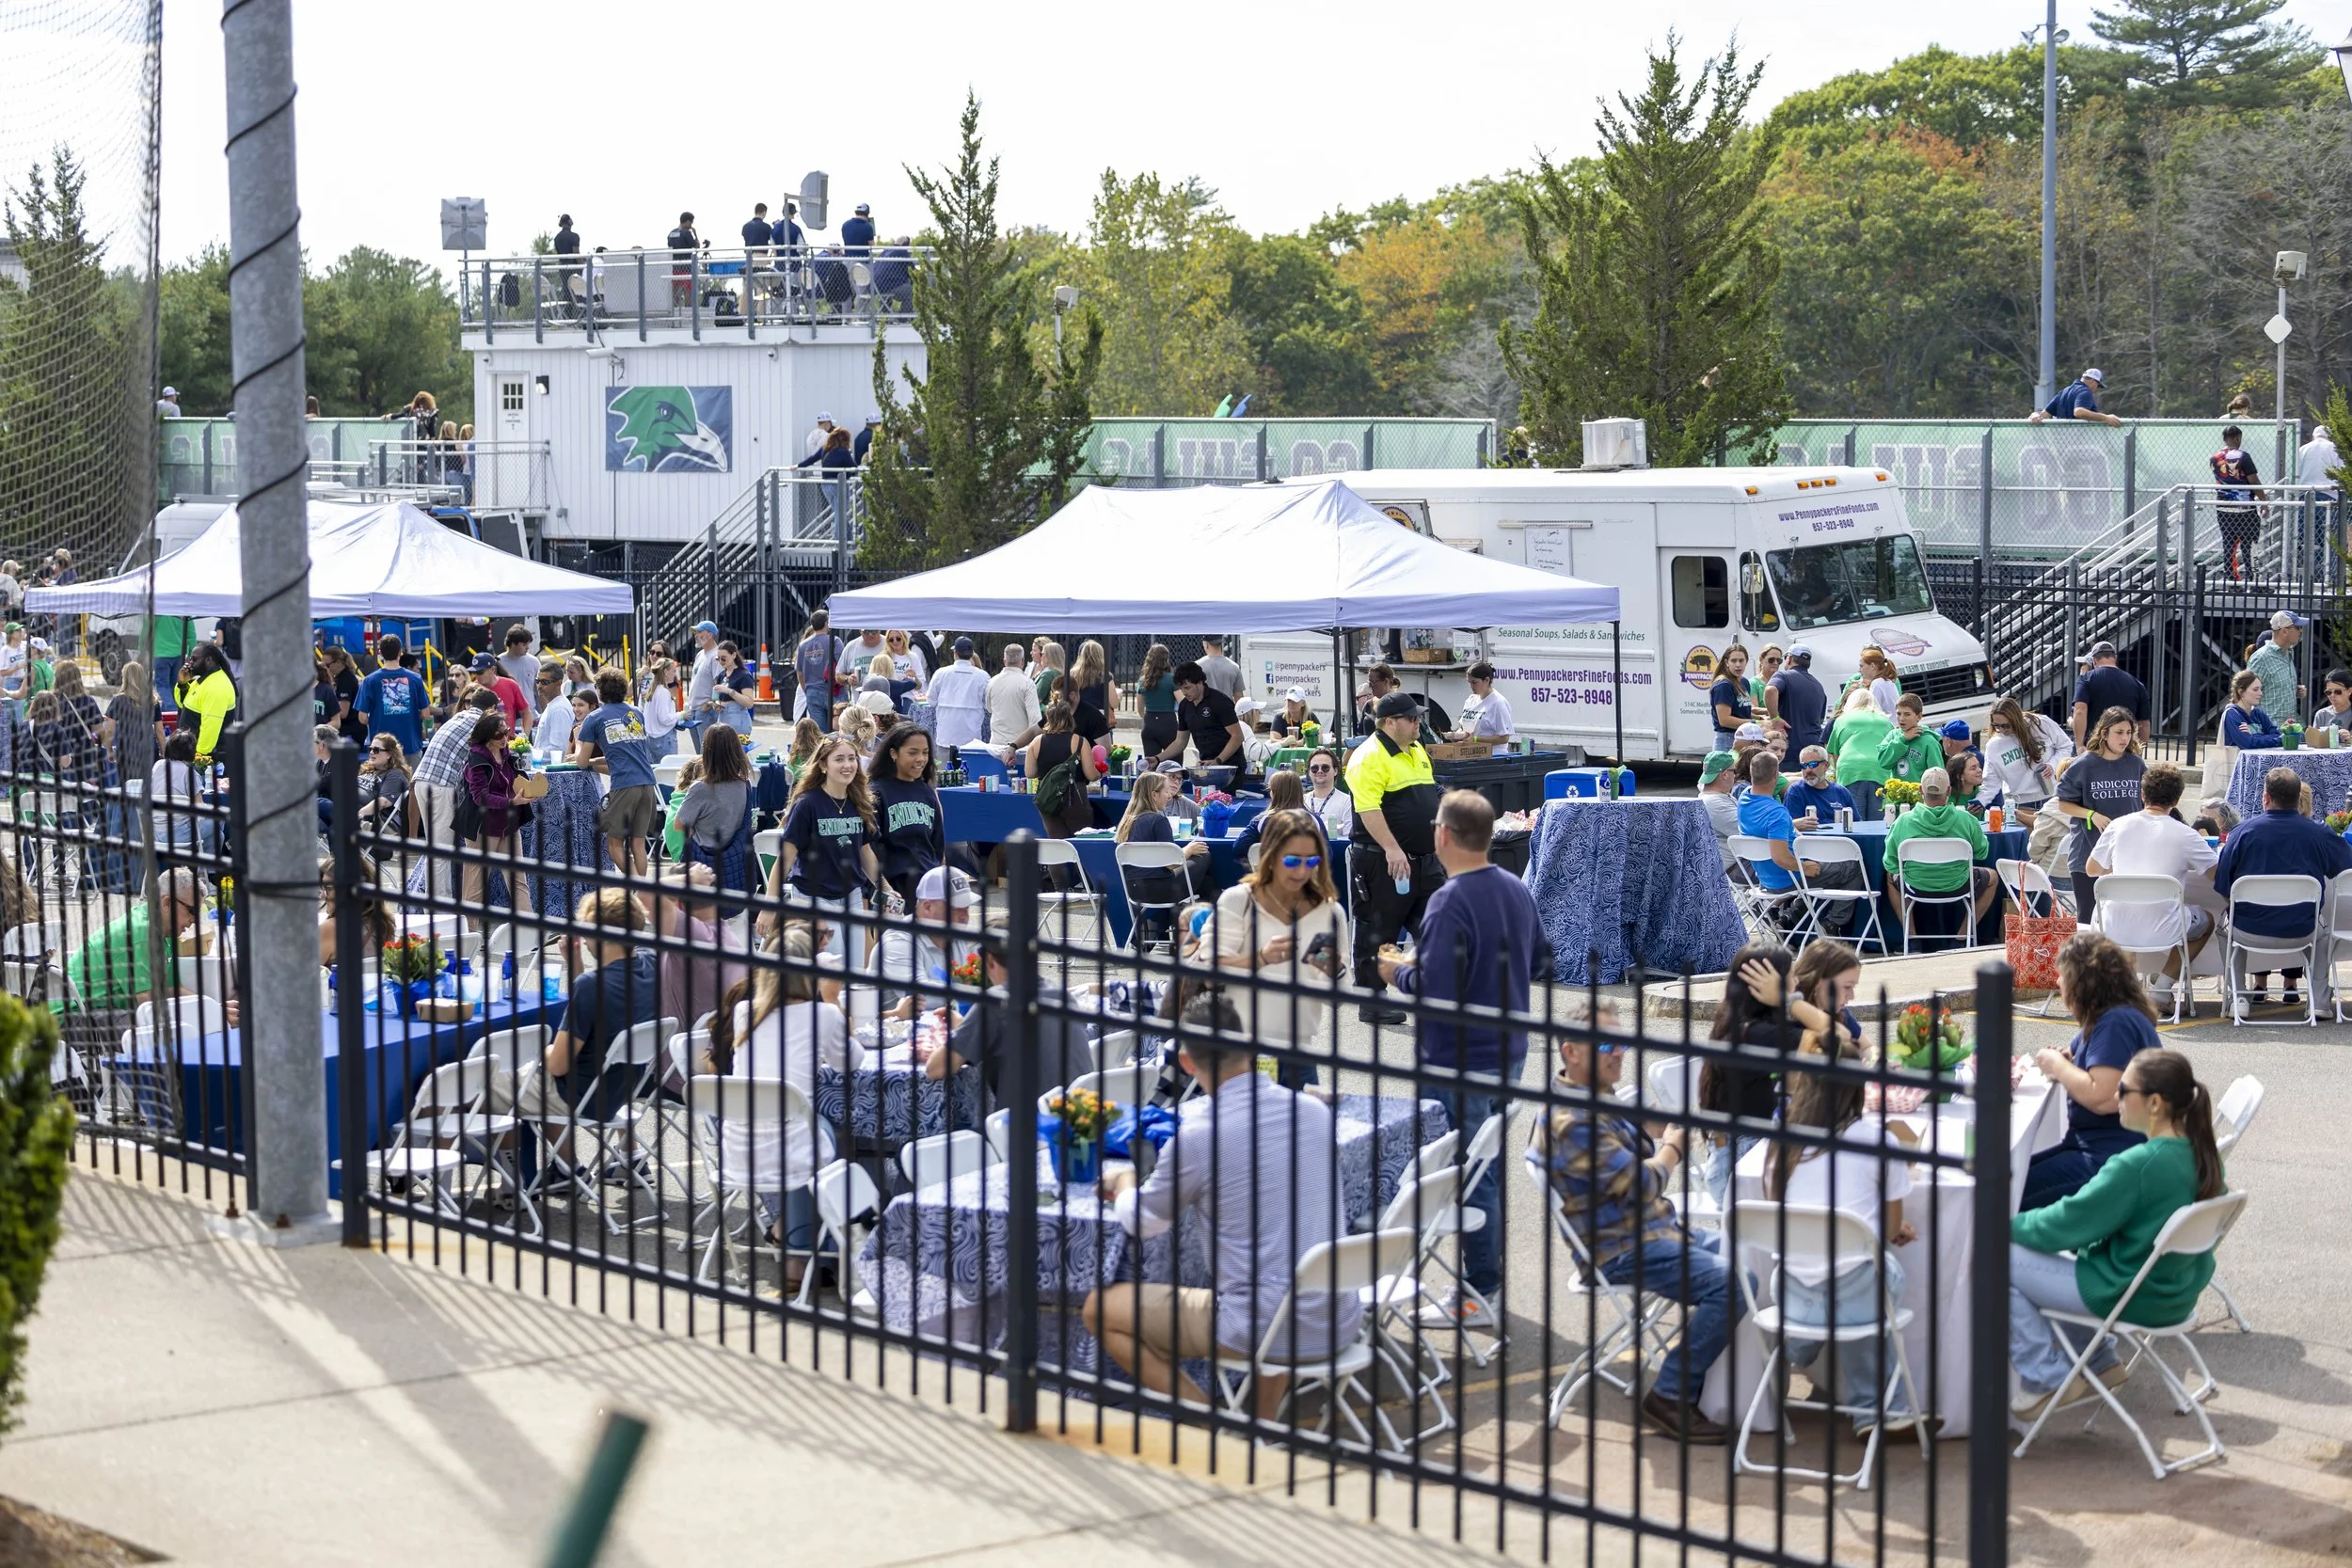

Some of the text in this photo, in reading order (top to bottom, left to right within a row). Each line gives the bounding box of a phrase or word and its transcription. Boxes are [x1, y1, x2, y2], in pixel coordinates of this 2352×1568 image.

[1778, 502, 1880, 521] www.PennypackersFineFoods.com
[1812, 518, 1854, 532] 857-523-8948
[1498, 627, 1534, 638] Seasonal
[1534, 628, 1561, 640] Soups,
[1562, 629, 1588, 640] Salads
[1589, 629, 1596, 640] &
[1274, 661, 1327, 673] @pennypackers
[1275, 673, 1321, 685] pennypackers
[1276, 688, 1322, 698] penckers
[1531, 687, 1613, 705] 857-523-8948
[2090, 779, 2139, 790] ENDICOTT
[2091, 789, 2138, 800] COLLEGE
